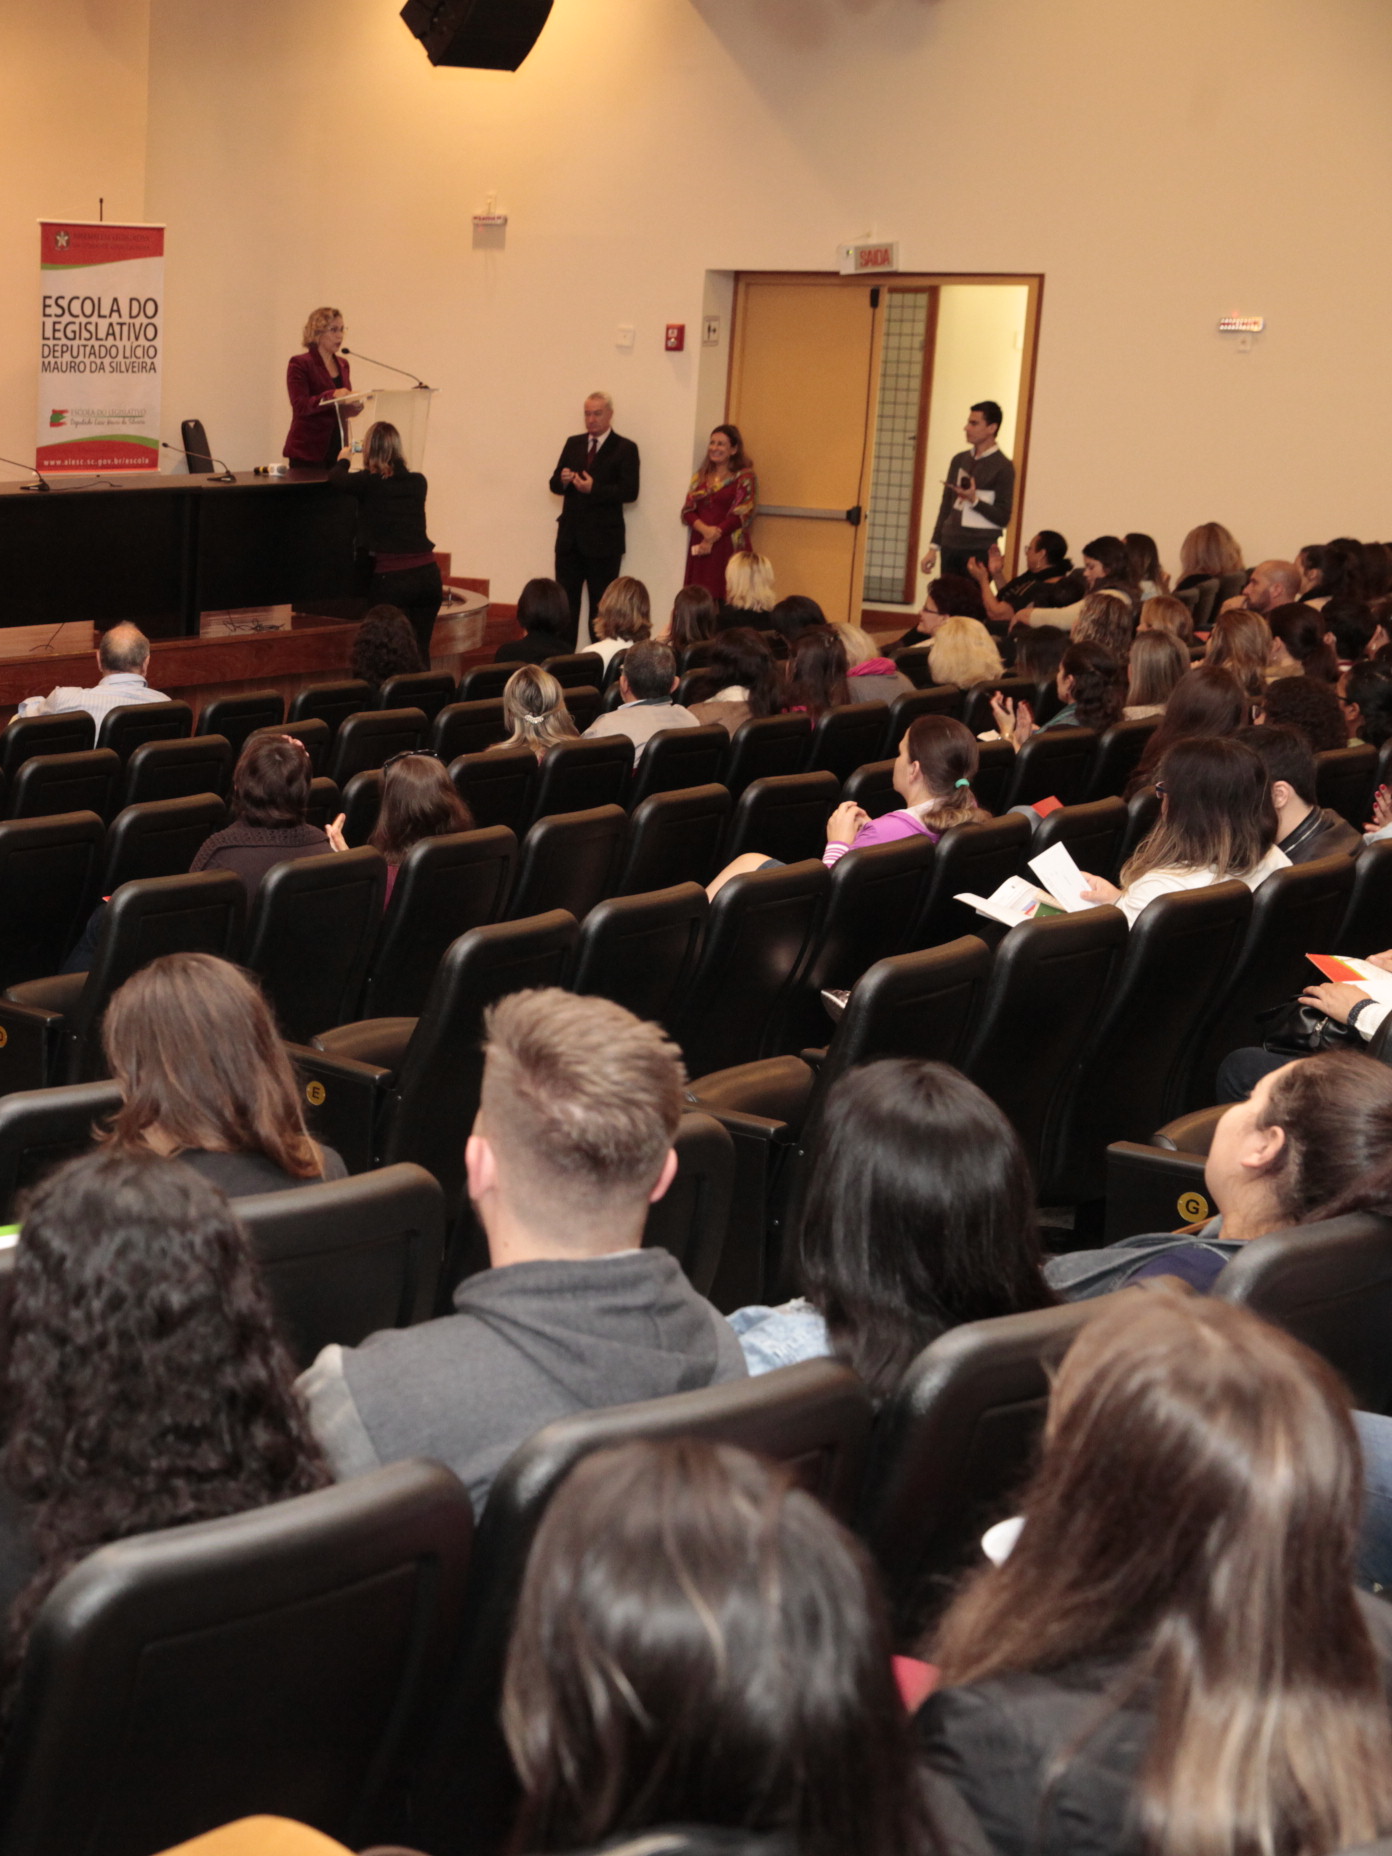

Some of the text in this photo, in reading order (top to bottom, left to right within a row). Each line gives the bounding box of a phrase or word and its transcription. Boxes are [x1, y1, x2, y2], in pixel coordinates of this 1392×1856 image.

[42, 296, 159, 319] ESCOLA DO
[41, 321, 159, 342] LEGISLATIVO
[41, 342, 158, 360] DEPUTADO LÍCIO
[41, 360, 157, 374] MAURO DA SILVEIRA
[43, 456, 150, 467] www.alesc.sc.gov.br/escola
[1185, 1199, 1200, 1215] G
